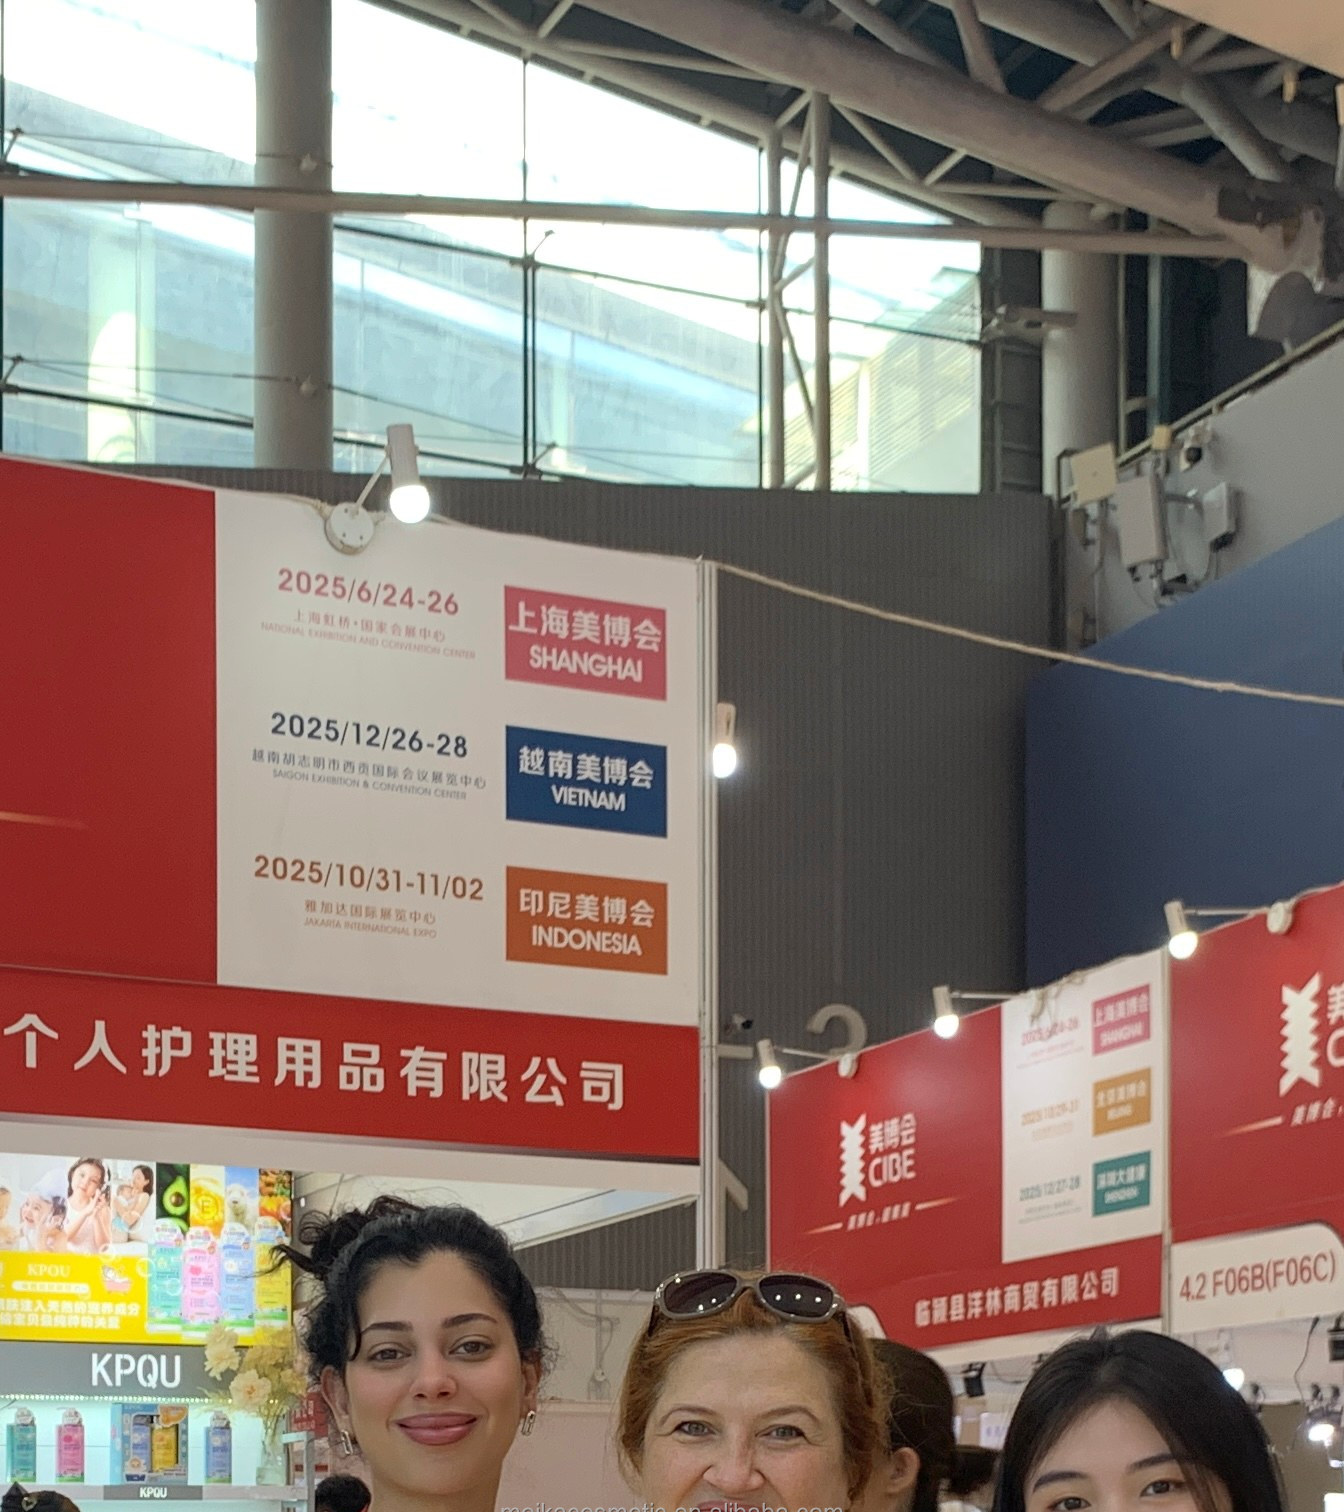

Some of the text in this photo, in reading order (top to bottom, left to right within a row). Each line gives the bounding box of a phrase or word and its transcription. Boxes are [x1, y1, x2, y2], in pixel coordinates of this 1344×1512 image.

[278, 567, 460, 616] 2025/6/24-26
[508, 600, 662, 653] 上海美博会
[529, 644, 643, 684] SHANGHAI
[270, 710, 469, 760] 2025/12/26-28
[272, 769, 309, 782] SAIGON
[434, 789, 467, 801] CENTER
[518, 743, 655, 791] 越南美博会
[551, 786, 626, 812] VIETNAM
[254, 854, 485, 901] 2025/10/31-11/02
[519, 887, 656, 929] 印尼美博会
[531, 925, 643, 957] INDONESIA
[869, 1113, 916, 1155] 美博会
[869, 1148, 916, 1188] CIBE
[1180, 1250, 1336, 1302] 4.2 F06B(F06C)
[91, 1352, 181, 1389] KPQU
[140, 1487, 168, 1499] KPQU
